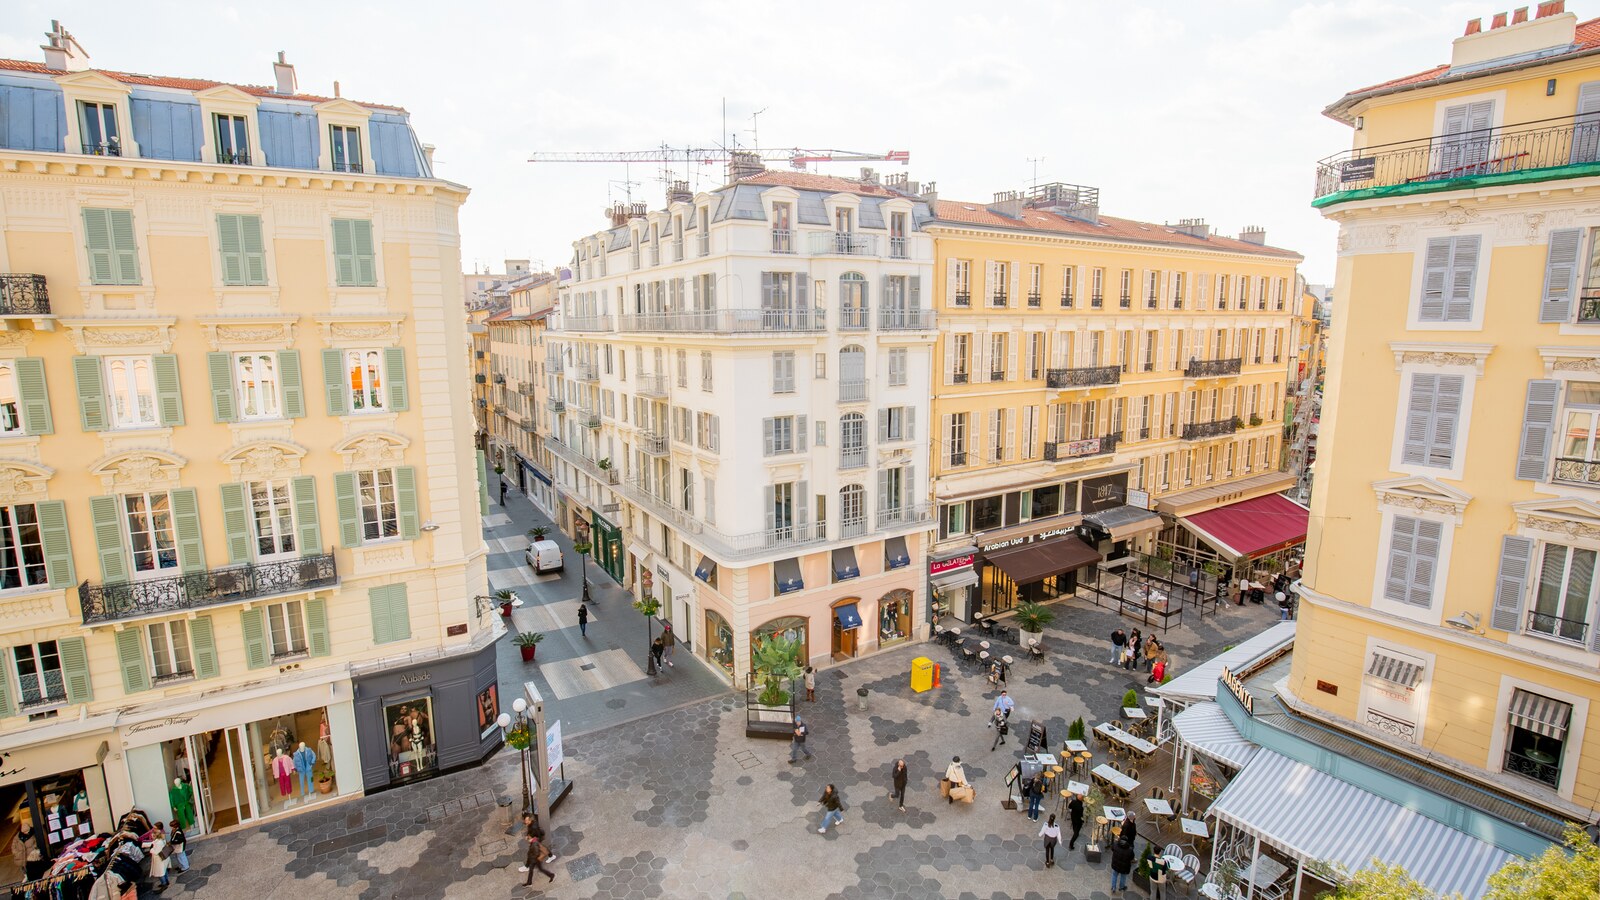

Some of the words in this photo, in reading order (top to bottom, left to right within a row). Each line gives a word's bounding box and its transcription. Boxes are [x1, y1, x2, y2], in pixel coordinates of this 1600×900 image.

[1097, 483, 1113, 498] 1817
[984, 541, 1009, 552] Arabian
[400, 670, 431, 685] Aubade
[1221, 665, 1253, 715] MAGENTA
[125, 722, 164, 737] American
[164, 714, 196, 726] Vintage
